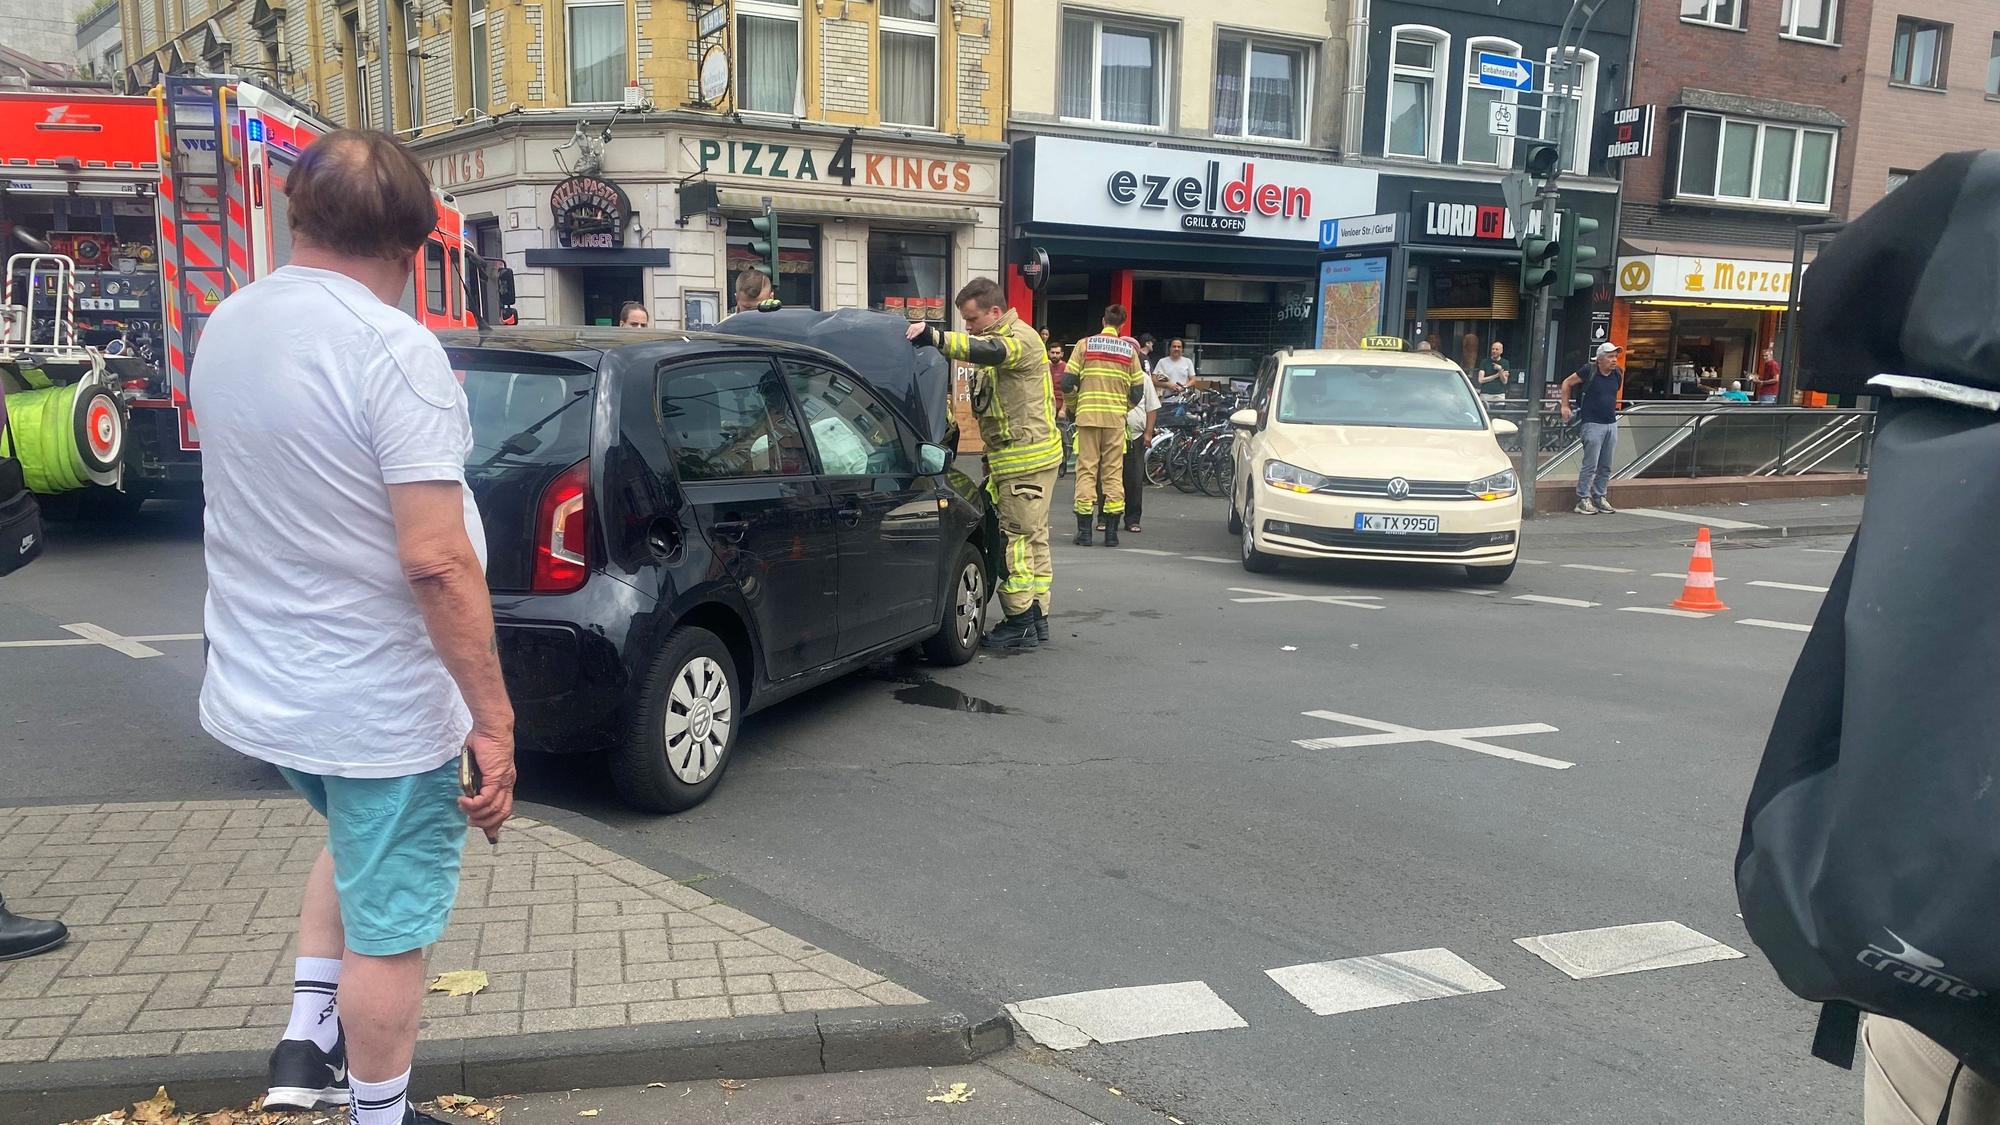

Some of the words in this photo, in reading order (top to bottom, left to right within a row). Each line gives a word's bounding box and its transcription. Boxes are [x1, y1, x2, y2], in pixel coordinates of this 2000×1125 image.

[1482, 64, 1518, 77] Einbahnstraße
[1614, 108, 1639, 125] LORD
[1608, 141, 1639, 158] DÖNER
[700, 139, 818, 181] PIZZA
[828, 137, 855, 186] 4
[865, 152, 971, 193] KINGS
[1108, 159, 1312, 218] ezelden
[1185, 216, 1209, 228] GRILL
[1211, 218, 1218, 229] &
[1220, 219, 1245, 230] OFEN
[1426, 202, 1478, 237] LORD
[1482, 211, 1499, 233] OF
[571, 233, 613, 248] BURGER
[1322, 222, 1335, 245] U
[1341, 228, 1361, 237] Venloer
[1369, 338, 1396, 346] TAXI
[1363, 516, 1373, 529] K
[1382, 516, 1399, 530] TX
[1402, 517, 1436, 532] 9950
[1856, 949, 1979, 1000] crane
